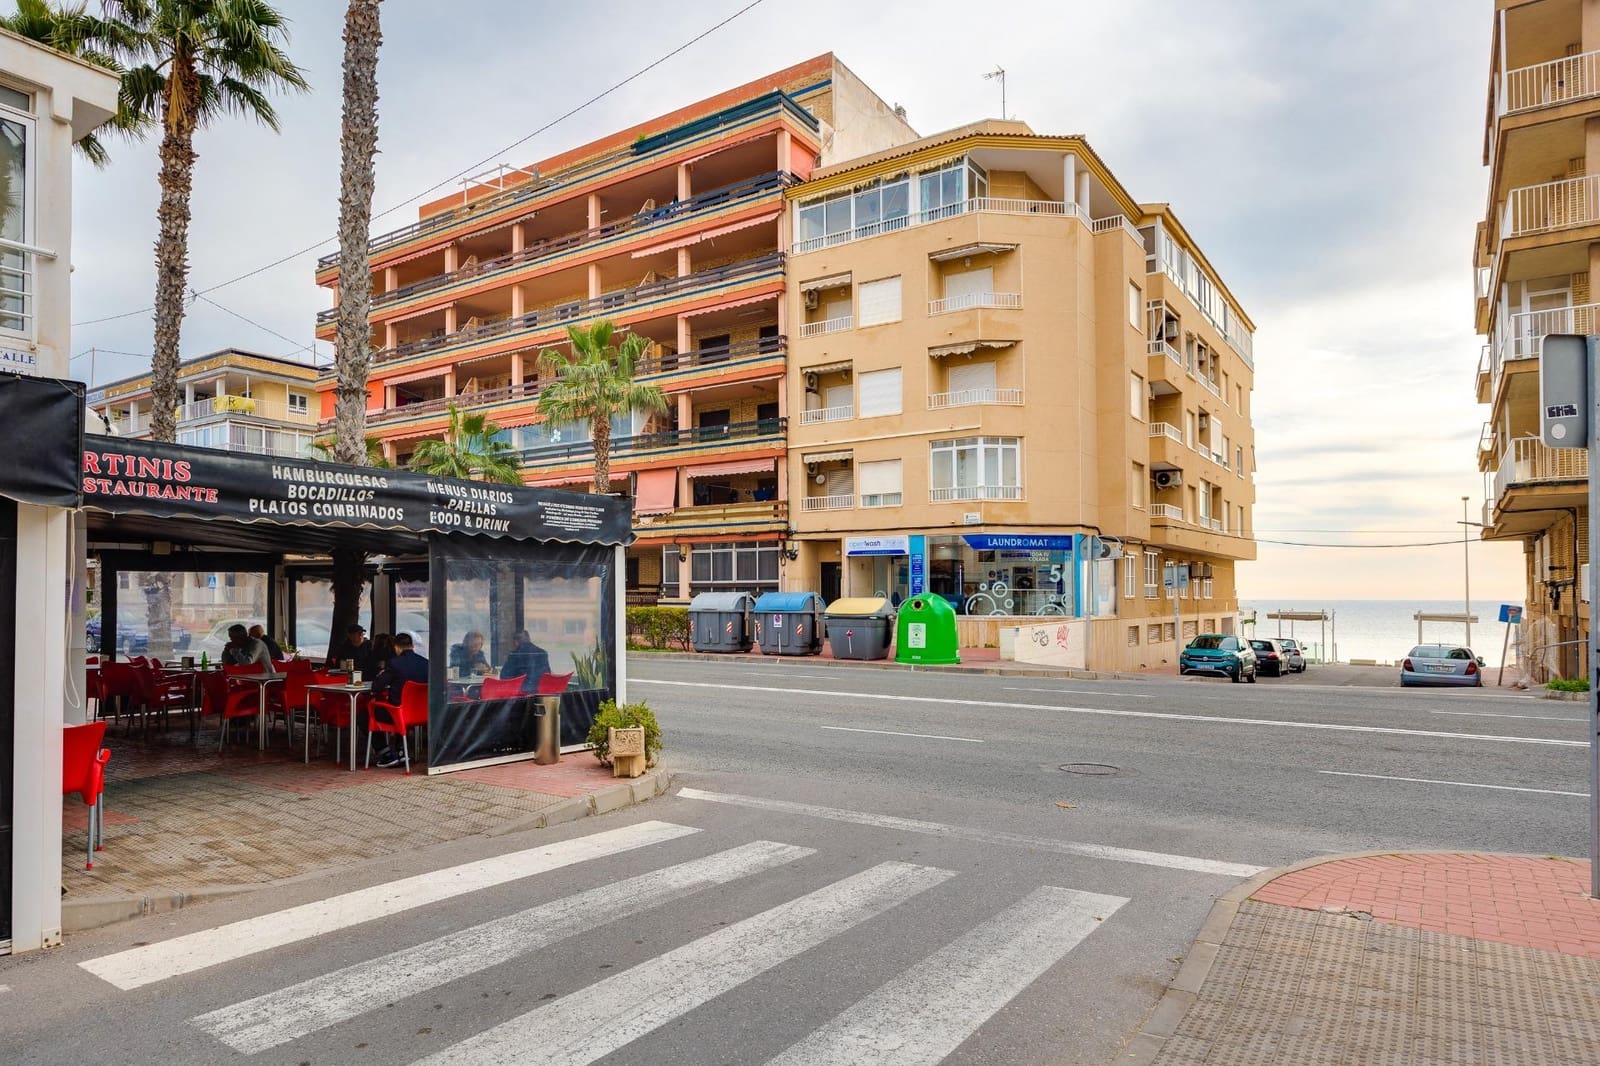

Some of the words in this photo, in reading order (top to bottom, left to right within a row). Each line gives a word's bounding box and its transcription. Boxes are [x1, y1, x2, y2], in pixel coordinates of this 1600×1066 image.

[271, 465, 389, 489] HAMBURGUESAS
[287, 484, 375, 502] BOCADILLOS
[470, 487, 513, 504] DIARIOS
[248, 498, 308, 516] PLATOS
[312, 502, 404, 521] COMBINADOS
[447, 498, 497, 516] PAELLAS
[464, 515, 472, 528] &
[475, 516, 511, 532] DRINK
[987, 537, 1049, 547] LAUNDROMAT
